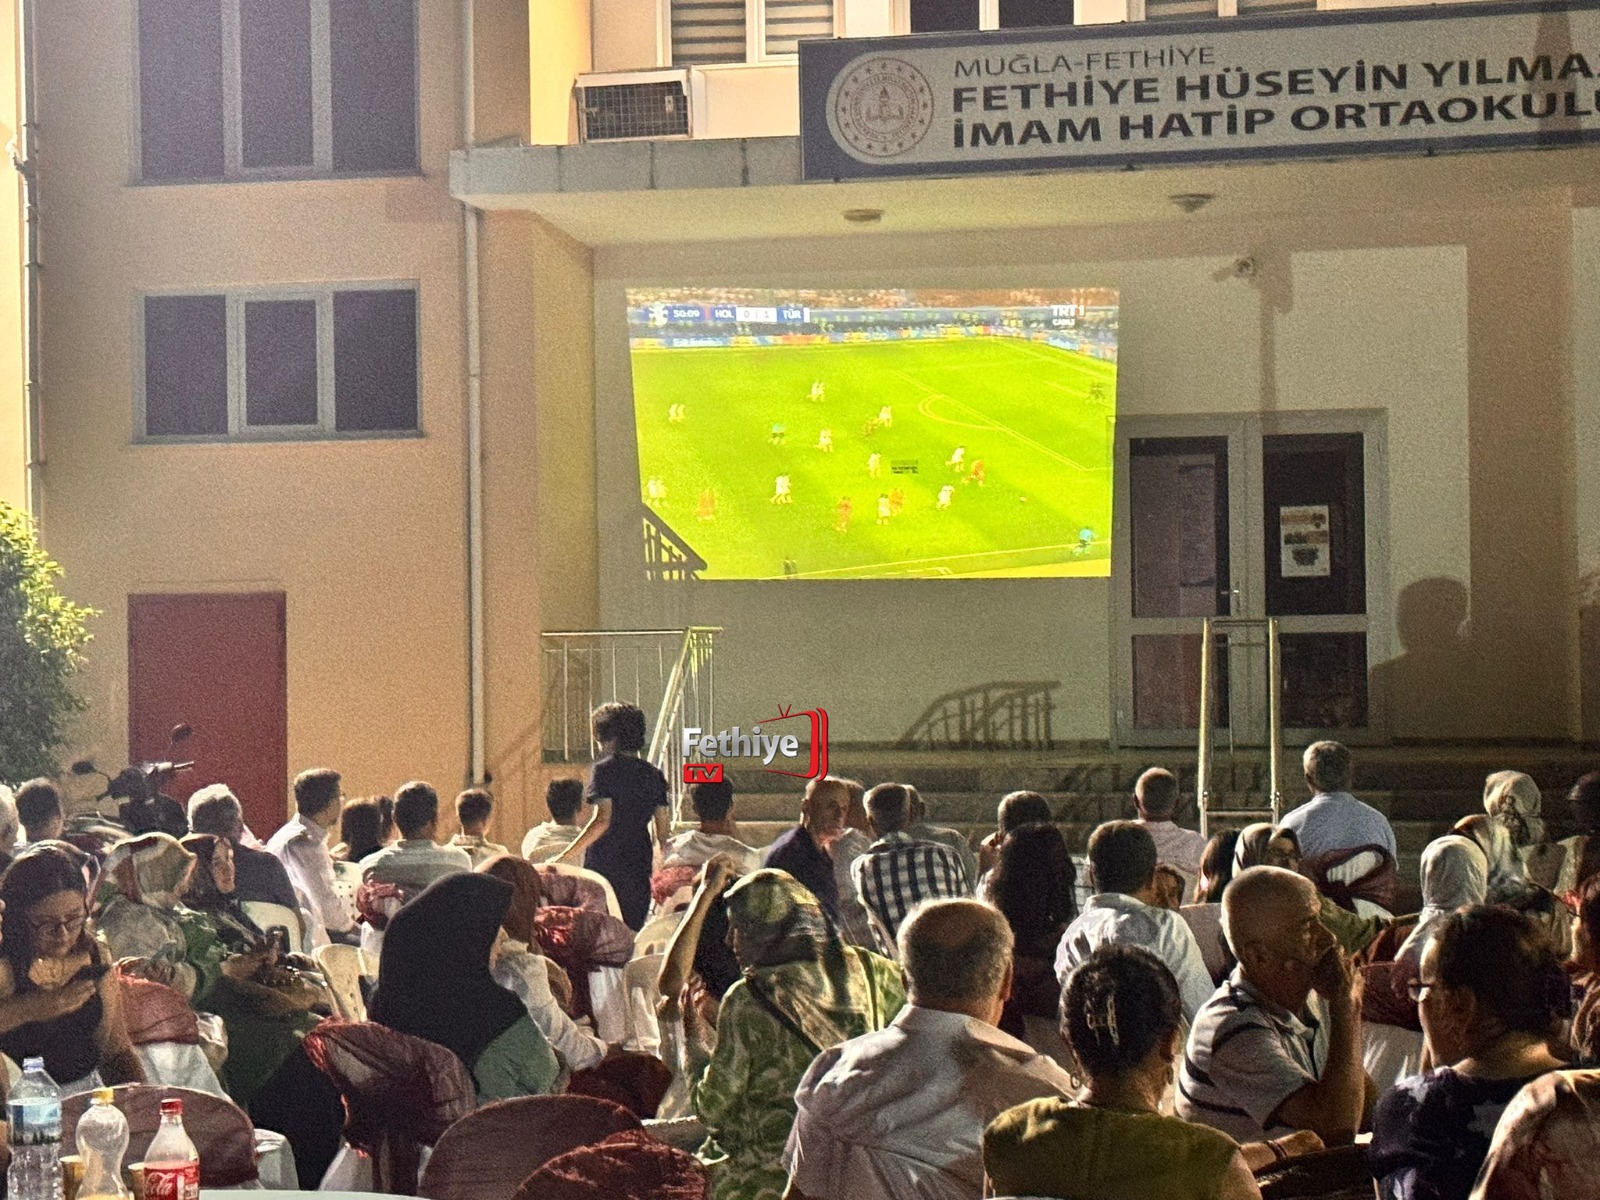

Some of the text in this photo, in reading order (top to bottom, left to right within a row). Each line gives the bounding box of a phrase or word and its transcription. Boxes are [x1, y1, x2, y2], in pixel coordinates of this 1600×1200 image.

[954, 46, 1216, 78] MUĞLA-FETHİYE
[953, 74, 1161, 112] FETHİYE
[1176, 59, 1408, 102] HÜSEYİN
[1421, 52, 1600, 88] YILMA
[953, 118, 1102, 148] İMAM
[1119, 104, 1276, 140] HATİP
[715, 308, 735, 319] HOL
[782, 307, 802, 319] TÜR
[1051, 304, 1077, 317] TRT
